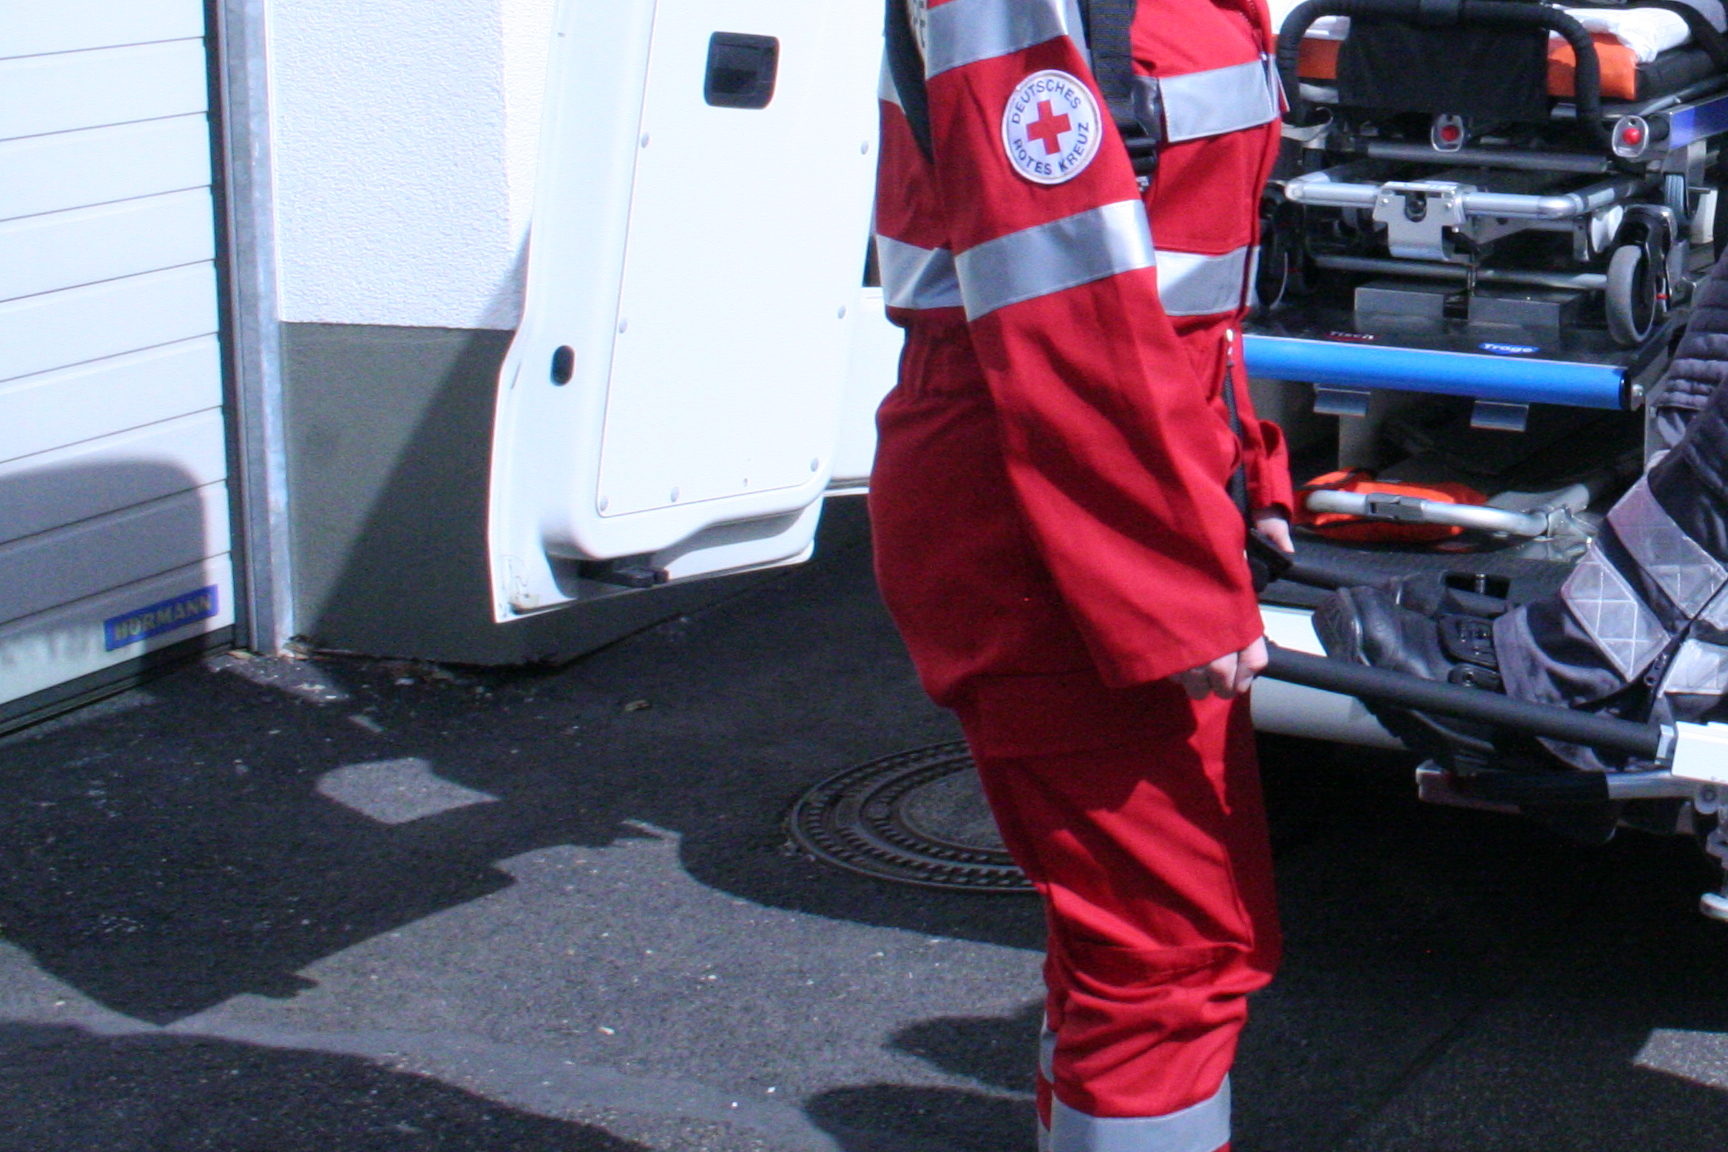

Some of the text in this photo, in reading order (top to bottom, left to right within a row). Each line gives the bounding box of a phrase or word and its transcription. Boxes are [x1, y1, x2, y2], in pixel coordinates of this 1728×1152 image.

[1011, 79, 1082, 125] DEUTSCHES
[1013, 121, 1090, 176] ROTES KREUZ
